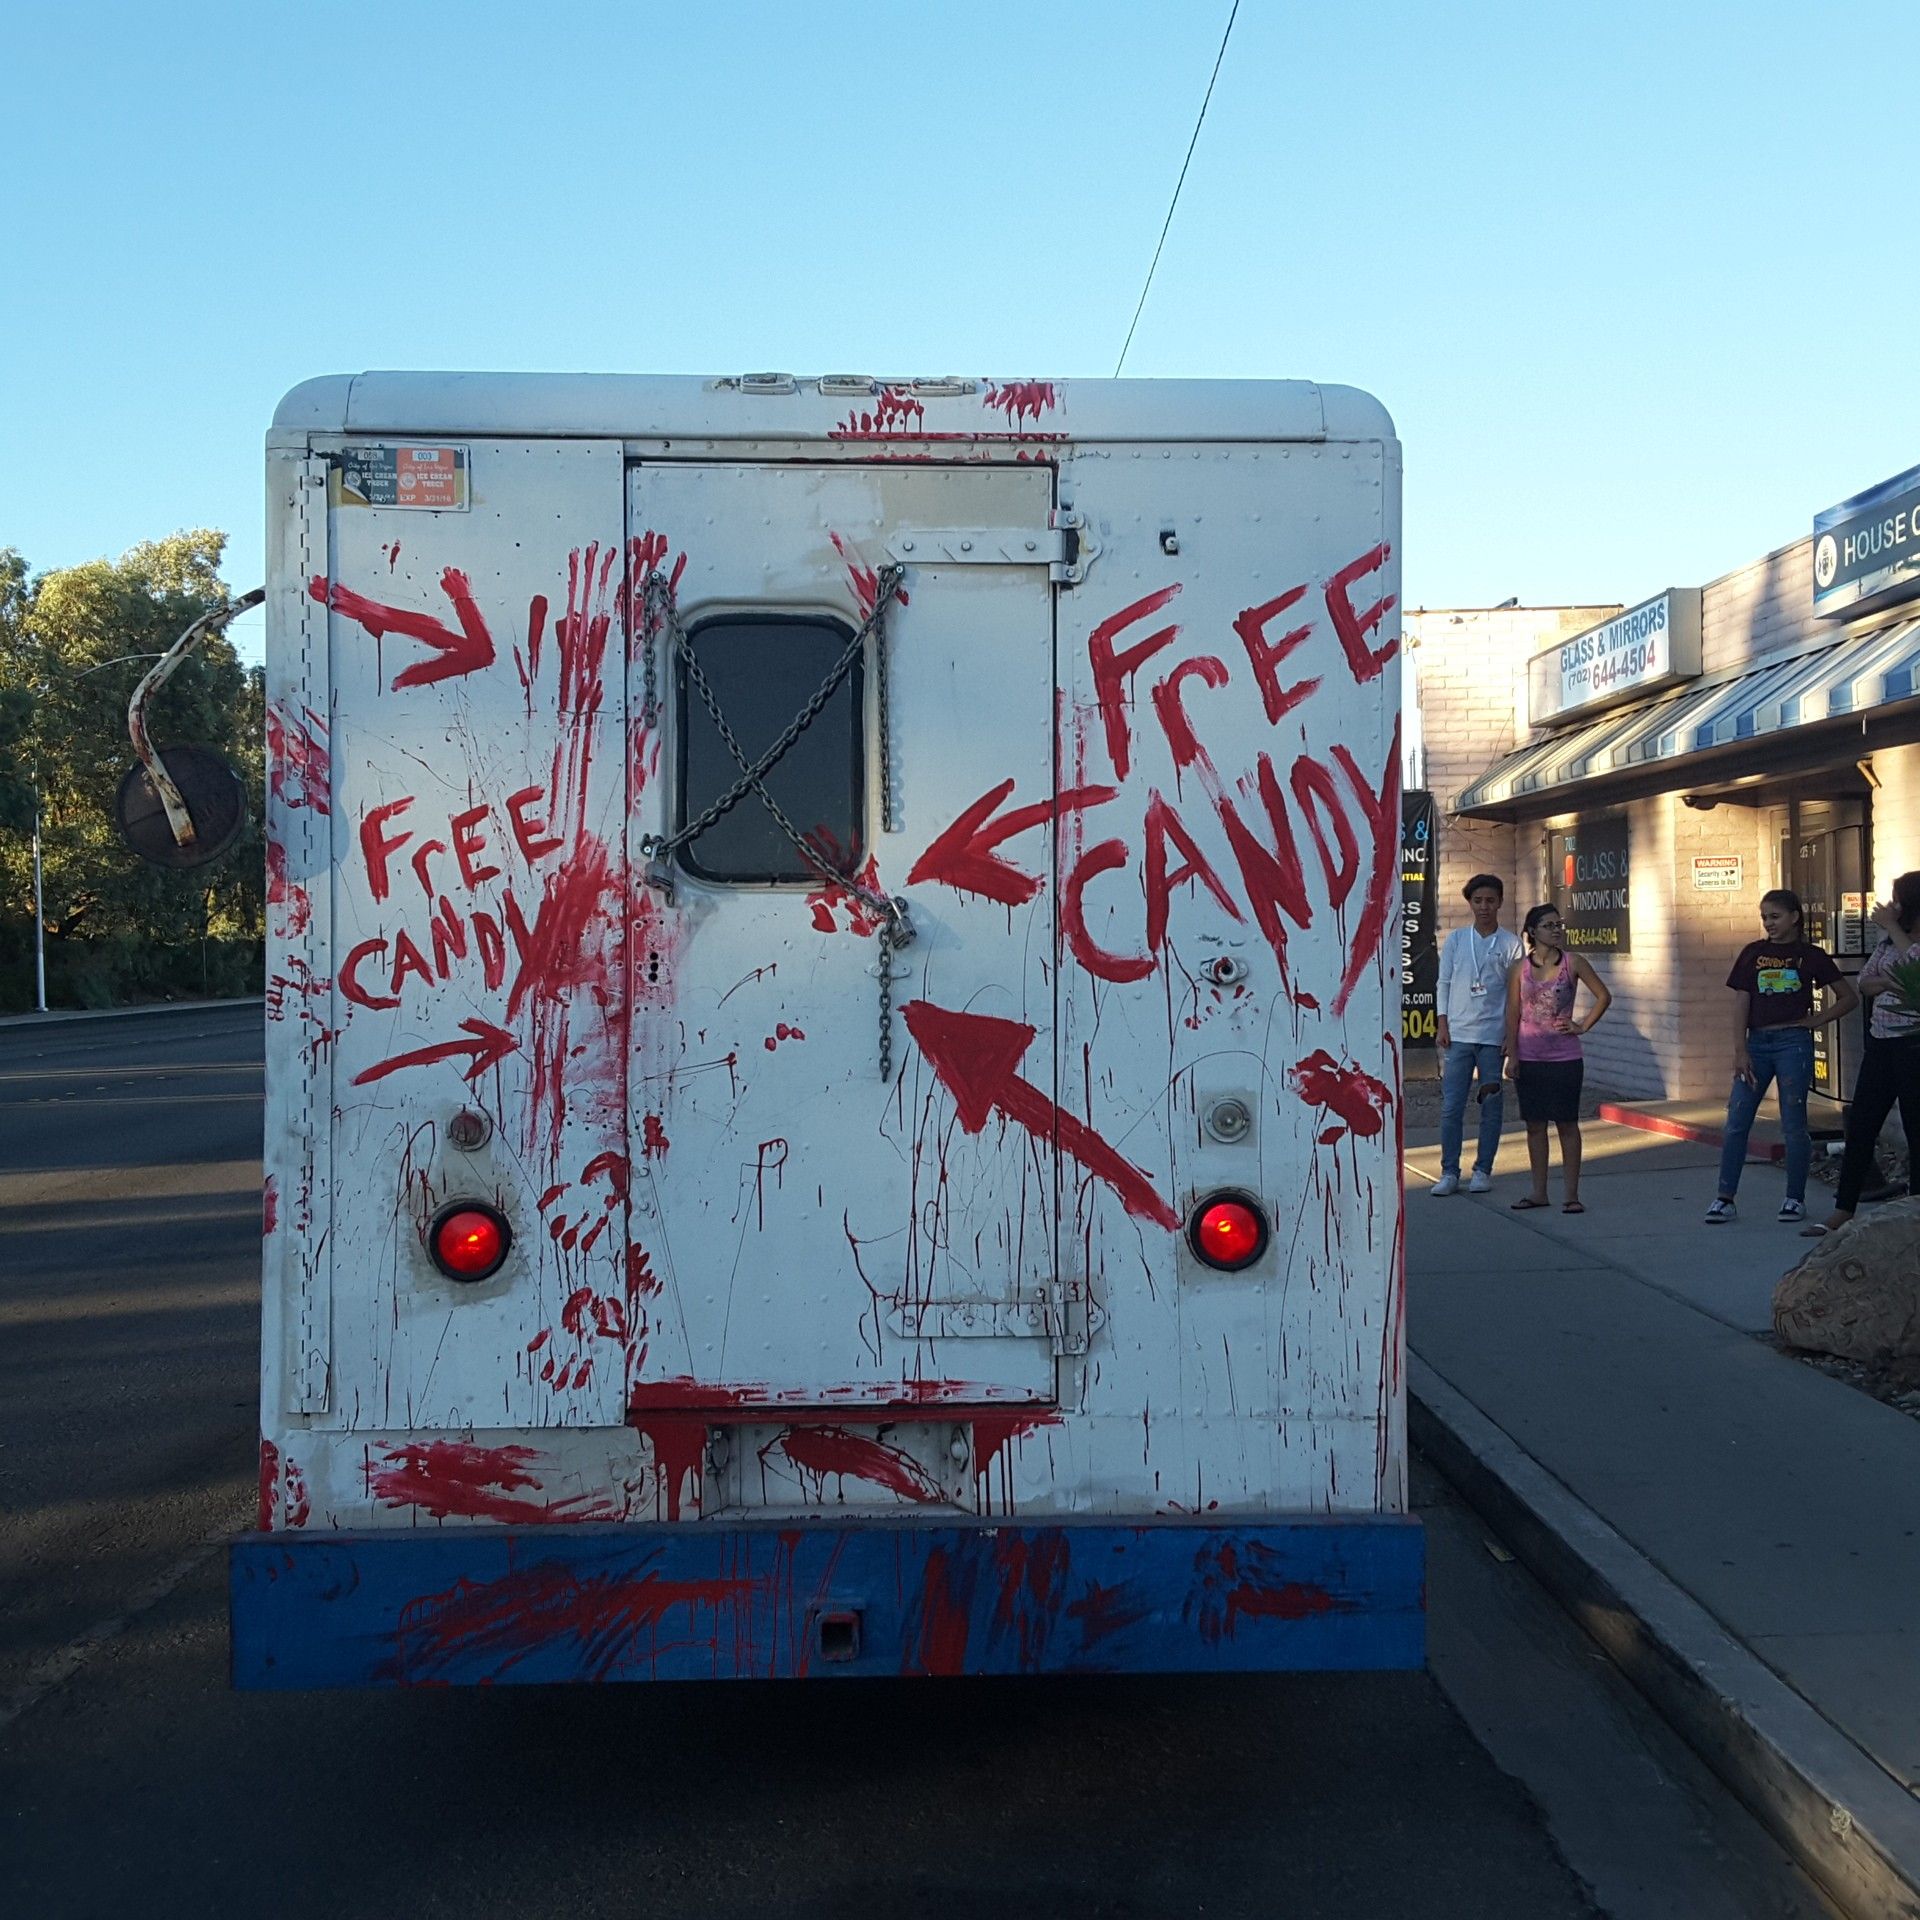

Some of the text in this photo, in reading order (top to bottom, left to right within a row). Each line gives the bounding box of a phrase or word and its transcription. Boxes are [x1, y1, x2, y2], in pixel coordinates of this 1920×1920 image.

[400, 494, 417, 502] EXP
[1844, 512, 1907, 567] HOUSE
[1560, 602, 1665, 673] GLASS & MIRRORS
[1568, 639, 1656, 691] (702) 644-4504
[1060, 710, 1402, 1019] CANDY
[1576, 851, 1616, 881] GLASS
[1697, 858, 1737, 867] WARNING
[1572, 888, 1630, 911] WINDOWS INC.
[338, 875, 565, 1025] CANDY
[1565, 928, 1618, 945] 702-644-4504
